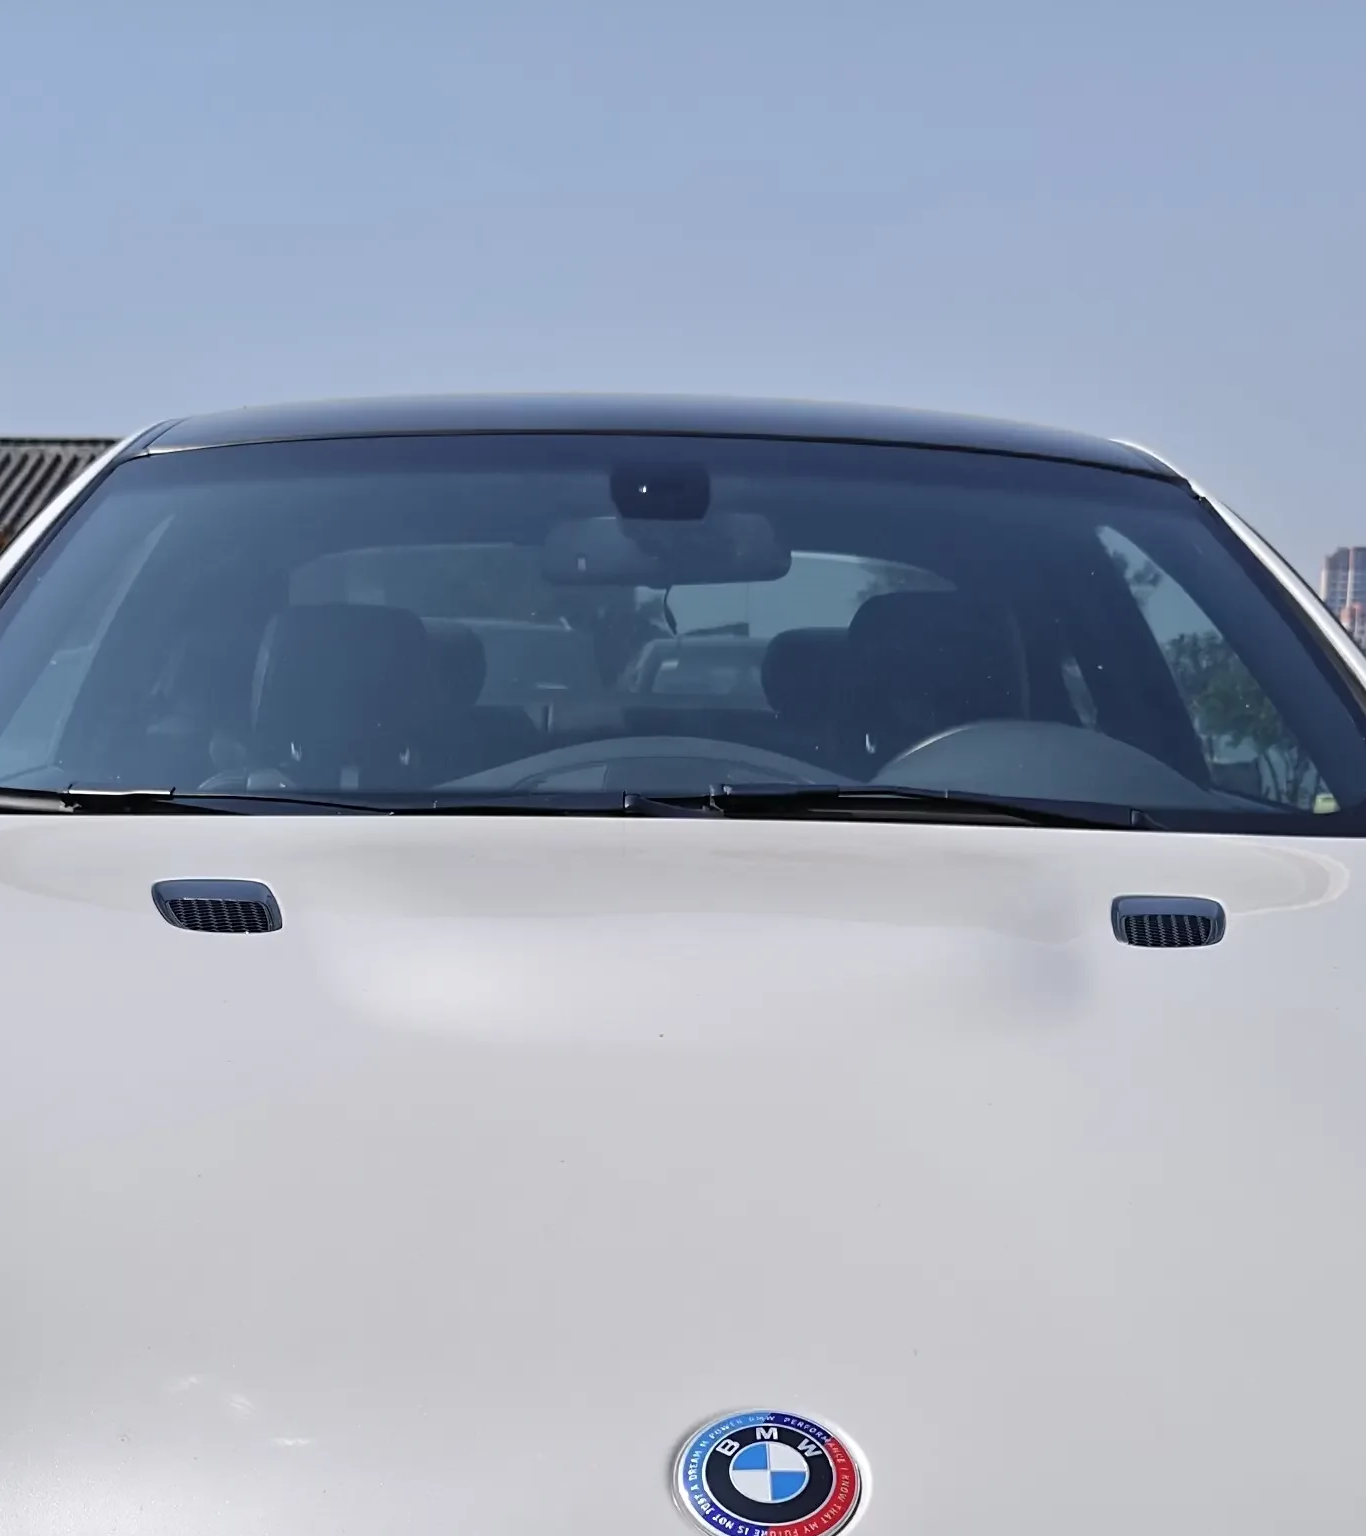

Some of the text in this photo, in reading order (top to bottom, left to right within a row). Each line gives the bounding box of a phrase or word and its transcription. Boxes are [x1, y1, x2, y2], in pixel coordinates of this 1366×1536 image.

[715, 1426, 823, 1458] BMW
[838, 1474, 850, 1502] KNOW
[712, 1513, 735, 1530] NOT
[820, 1503, 842, 1524] THAT
[736, 1525, 750, 1535] IS
[803, 1521, 819, 1534] MY
